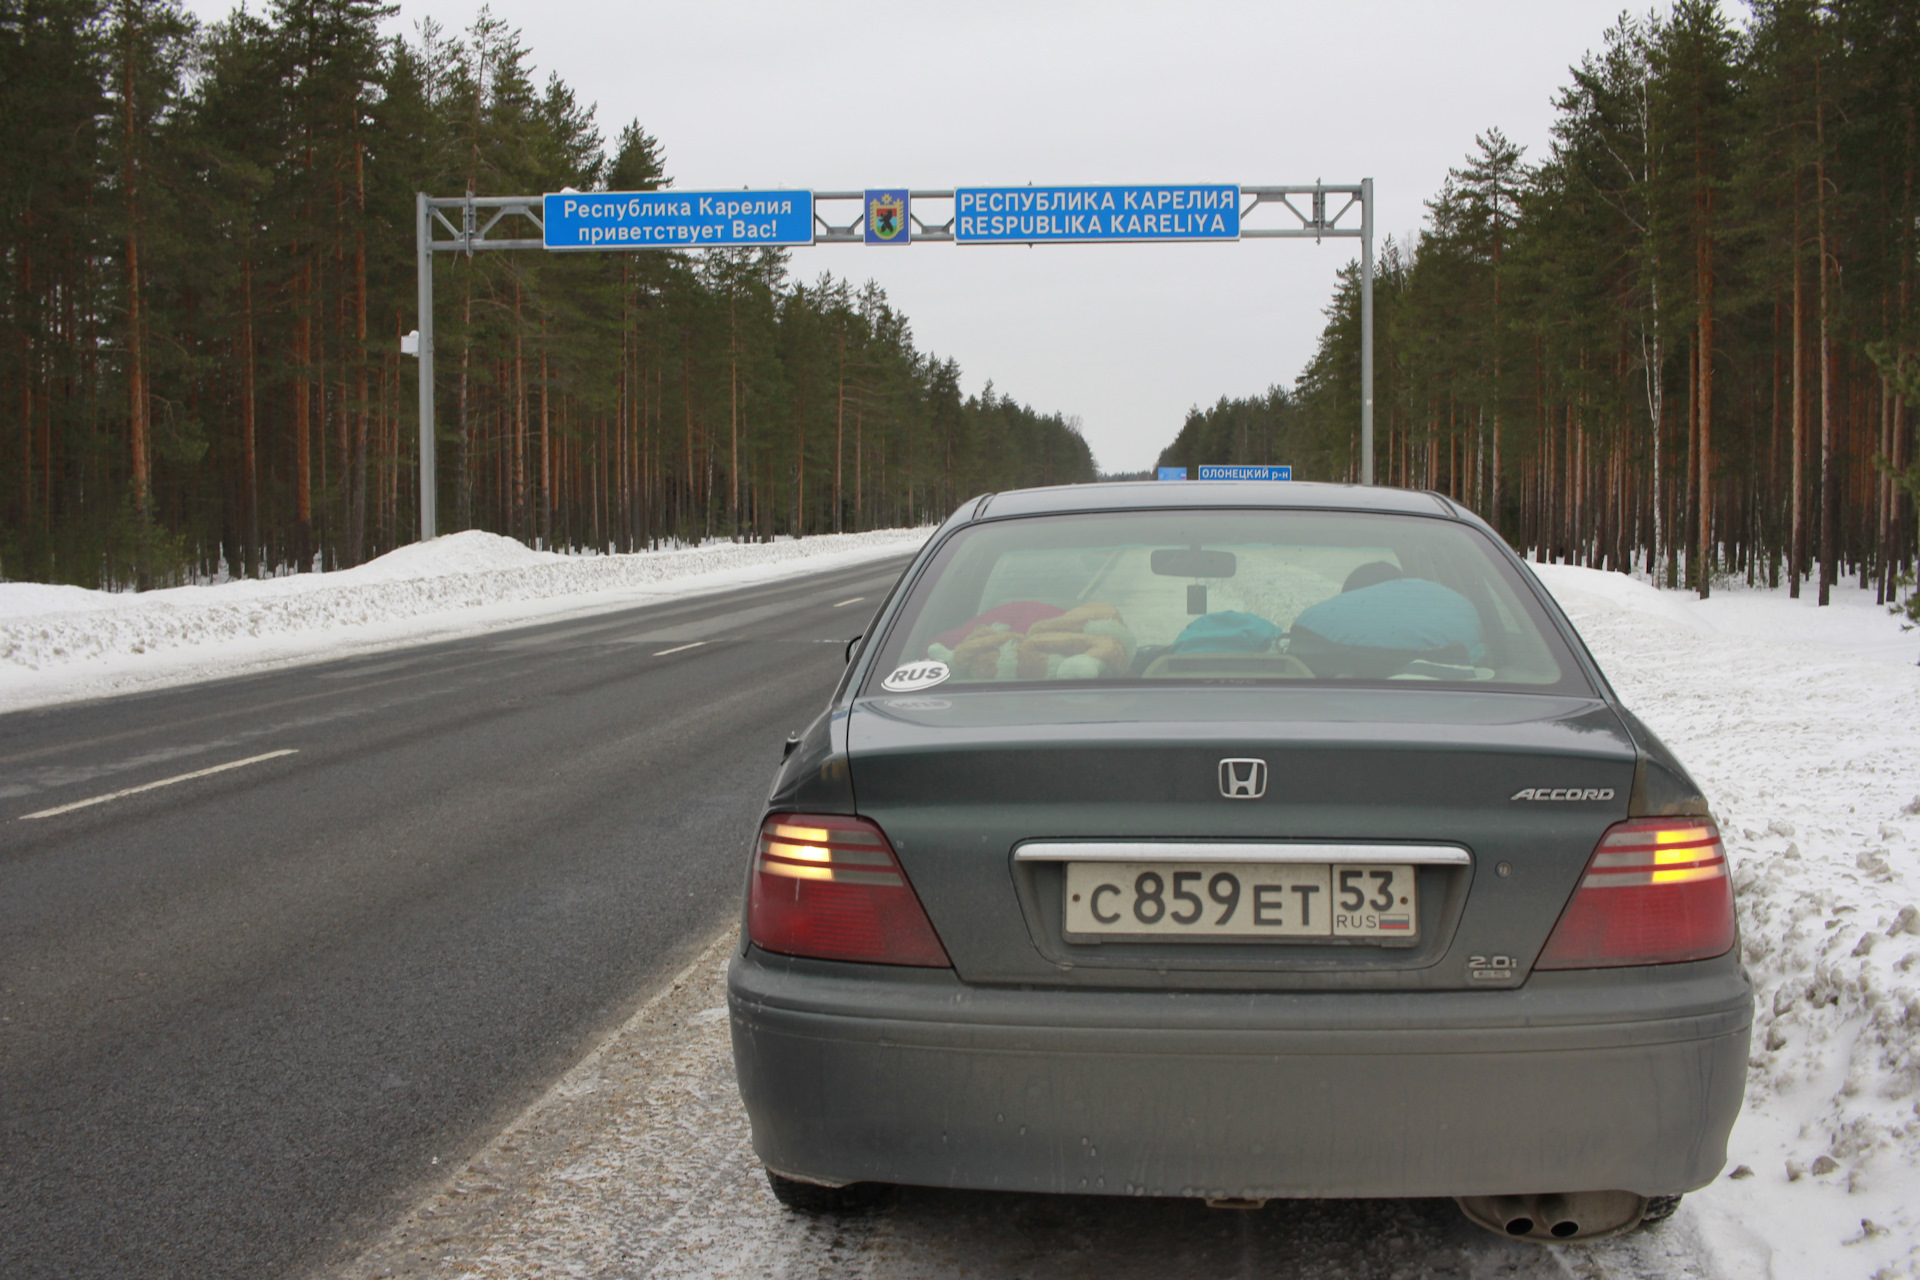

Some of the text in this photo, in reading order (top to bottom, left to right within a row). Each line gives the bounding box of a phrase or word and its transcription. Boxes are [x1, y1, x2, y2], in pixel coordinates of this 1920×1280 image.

[564, 196, 792, 221] Республика Карелия
[960, 190, 1234, 213] РЕСПУБЛИКА КАРЕЛИЯ
[578, 219, 777, 245] приветствует Вас!
[960, 213, 1226, 235] RESPUBLIKA KARELIYA
[1202, 467, 1269, 480] ОЛОНЕЦКИЙ
[890, 667, 944, 683] RUS
[1510, 788, 1615, 801] ACCORD
[1339, 870, 1394, 912] 53
[1336, 914, 1377, 929] RUS
[1468, 956, 1517, 969] 2.0i
